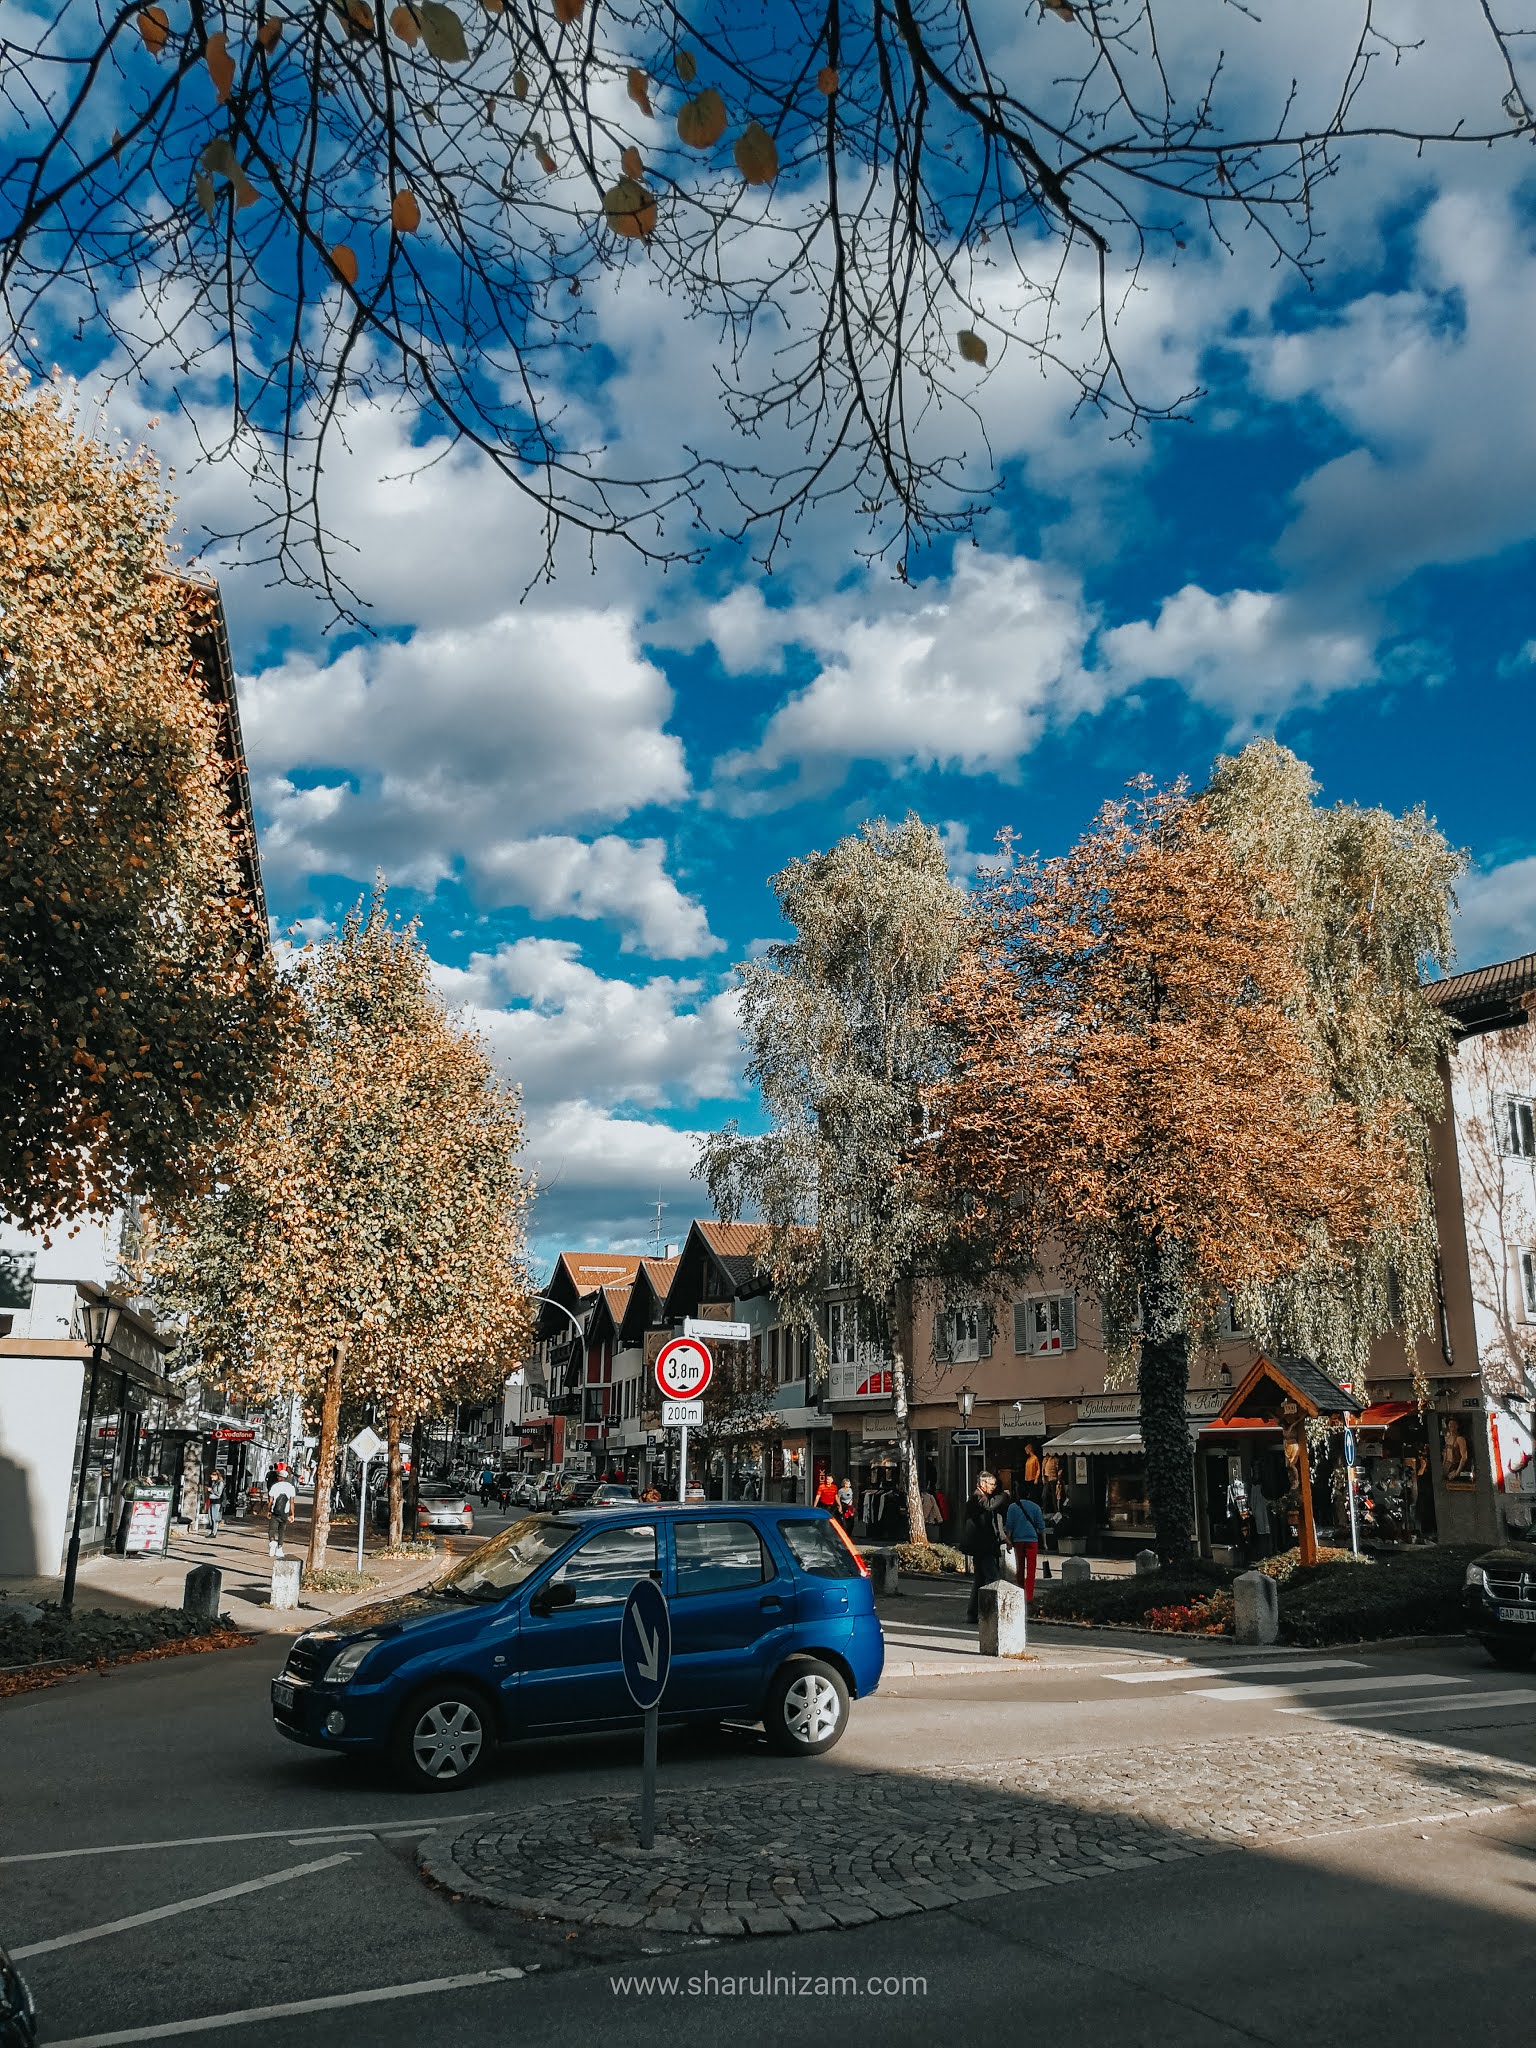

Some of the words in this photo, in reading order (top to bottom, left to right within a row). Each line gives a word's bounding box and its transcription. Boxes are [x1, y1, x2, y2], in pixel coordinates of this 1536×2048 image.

[668, 1358, 699, 1379] 3,8m
[667, 1407, 698, 1420] 200m
[1082, 1398, 1136, 1418] Goldschmiede
[648, 1436, 655, 1447] P
[136, 1489, 171, 1497] DEPOT
[1500, 1608, 1515, 1619] GAP
[1519, 1610, 1525, 1620] B
[1525, 1611, 1536, 1621] 11
